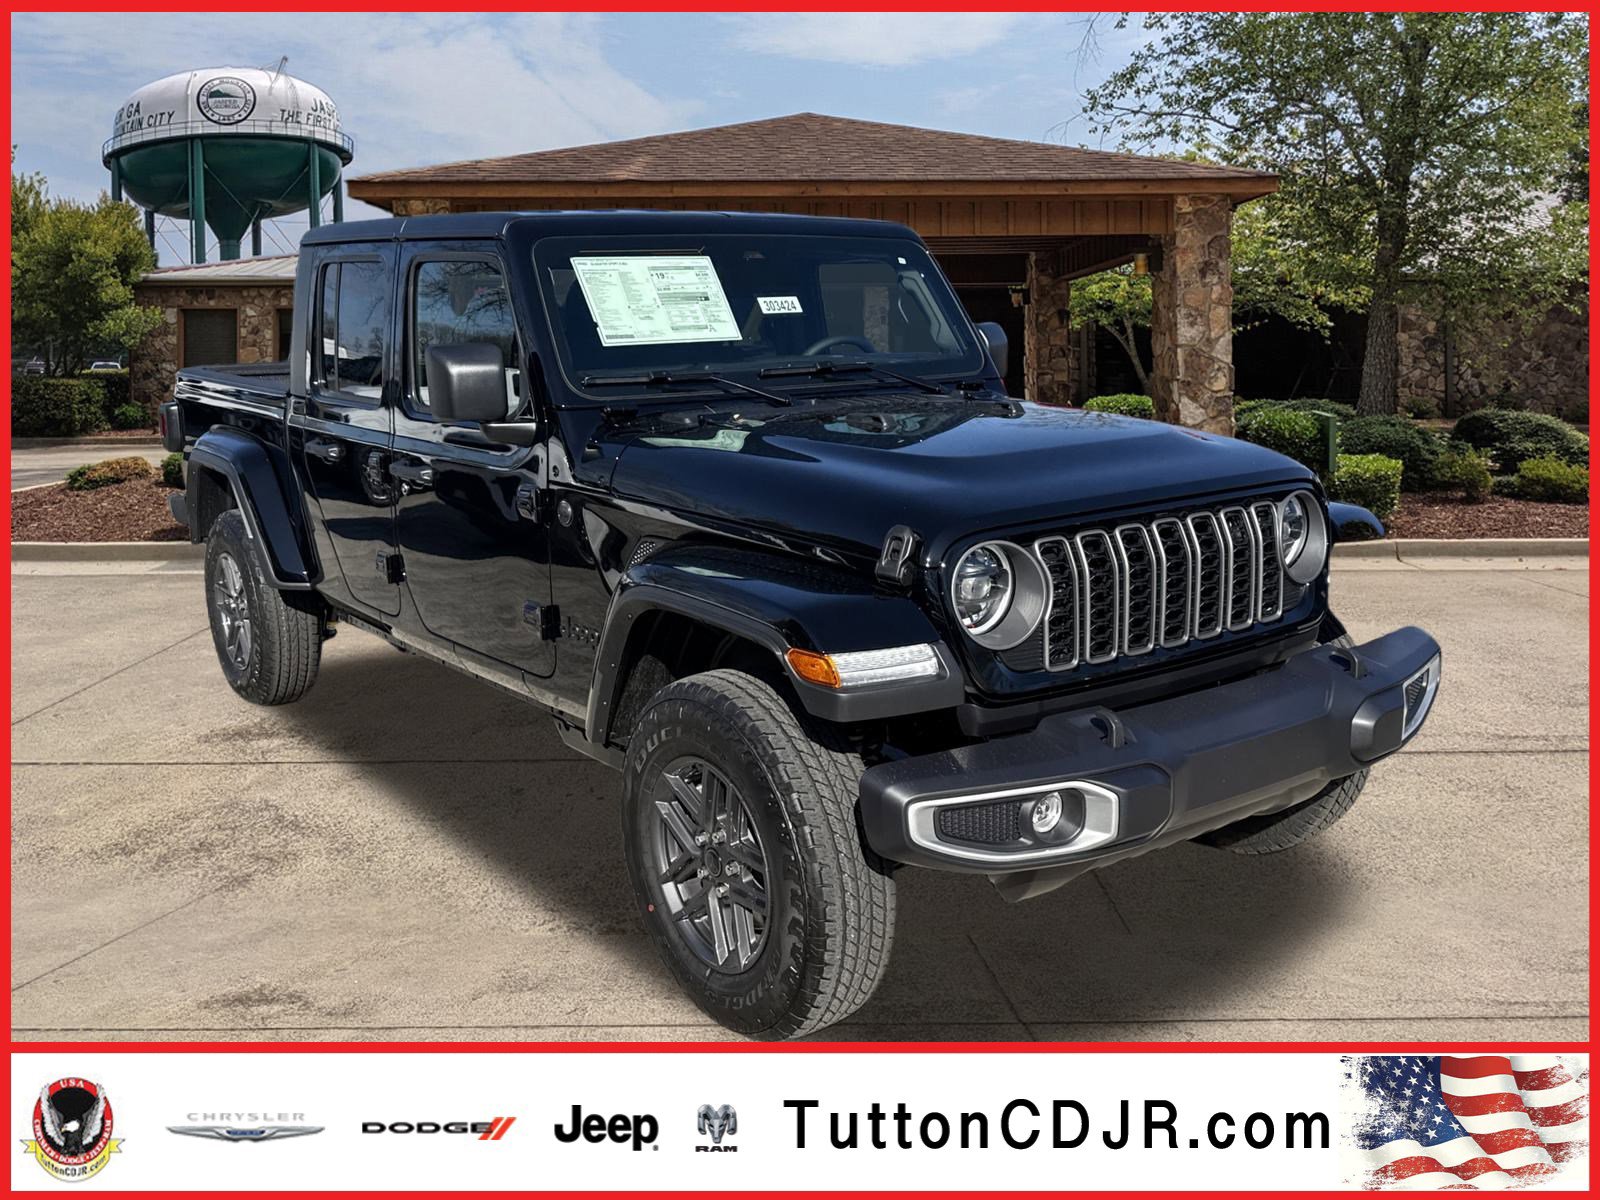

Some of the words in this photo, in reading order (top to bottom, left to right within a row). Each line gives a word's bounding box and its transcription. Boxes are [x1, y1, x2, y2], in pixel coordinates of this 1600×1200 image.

[126, 101, 141, 119] GA
[279, 108, 302, 124] THE
[147, 110, 176, 127] CITY
[763, 300, 797, 312] 303424
